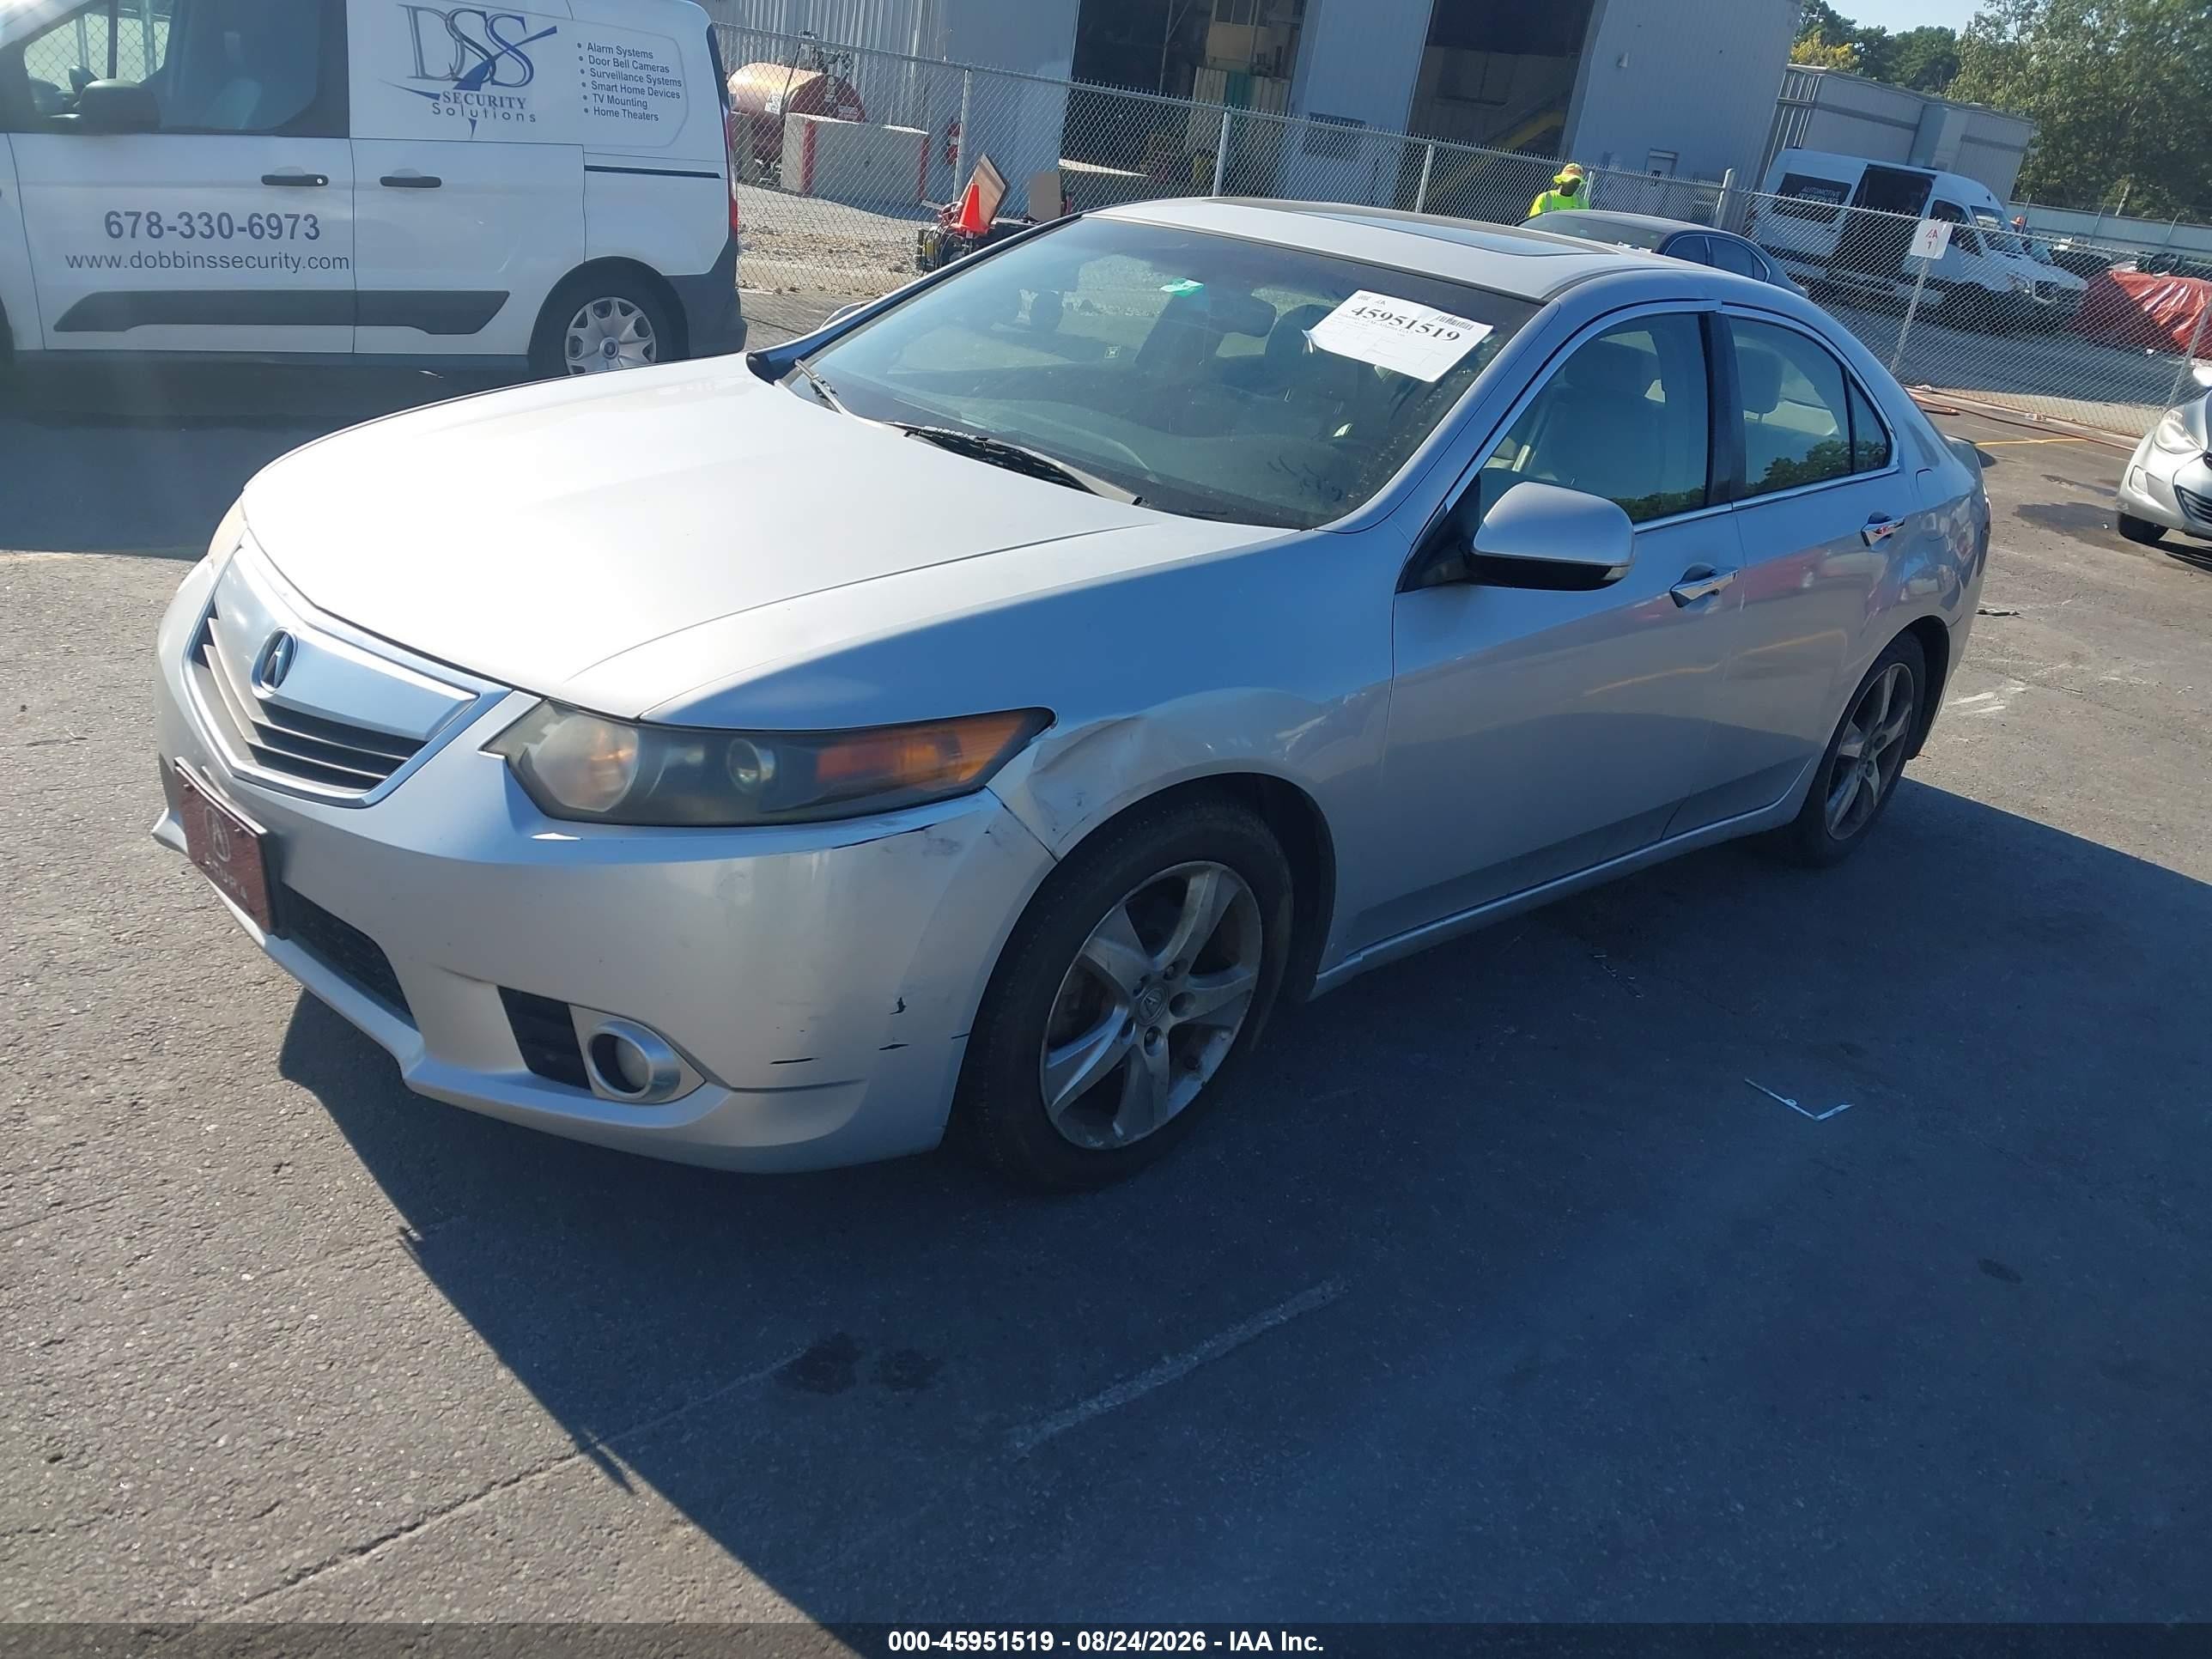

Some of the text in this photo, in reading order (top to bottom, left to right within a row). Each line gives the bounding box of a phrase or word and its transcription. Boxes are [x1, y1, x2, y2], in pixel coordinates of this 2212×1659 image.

[397, 4, 534, 88] DSS
[587, 42, 653, 59] Alarm Systems
[588, 54, 670, 73] Door Bell Cameras
[590, 68, 682, 88] Surveillance Systems
[442, 91, 526, 109] SECURITY
[591, 80, 680, 100] Smart Home Devices
[592, 93, 647, 110] TV Mounting
[432, 102, 536, 123] Solutions
[593, 106, 659, 121] Home Theaters
[104, 210, 320, 240] 678-330-6973
[64, 250, 350, 273] www.dobbinssecurity.com
[1351, 307, 1461, 341] 45951519
